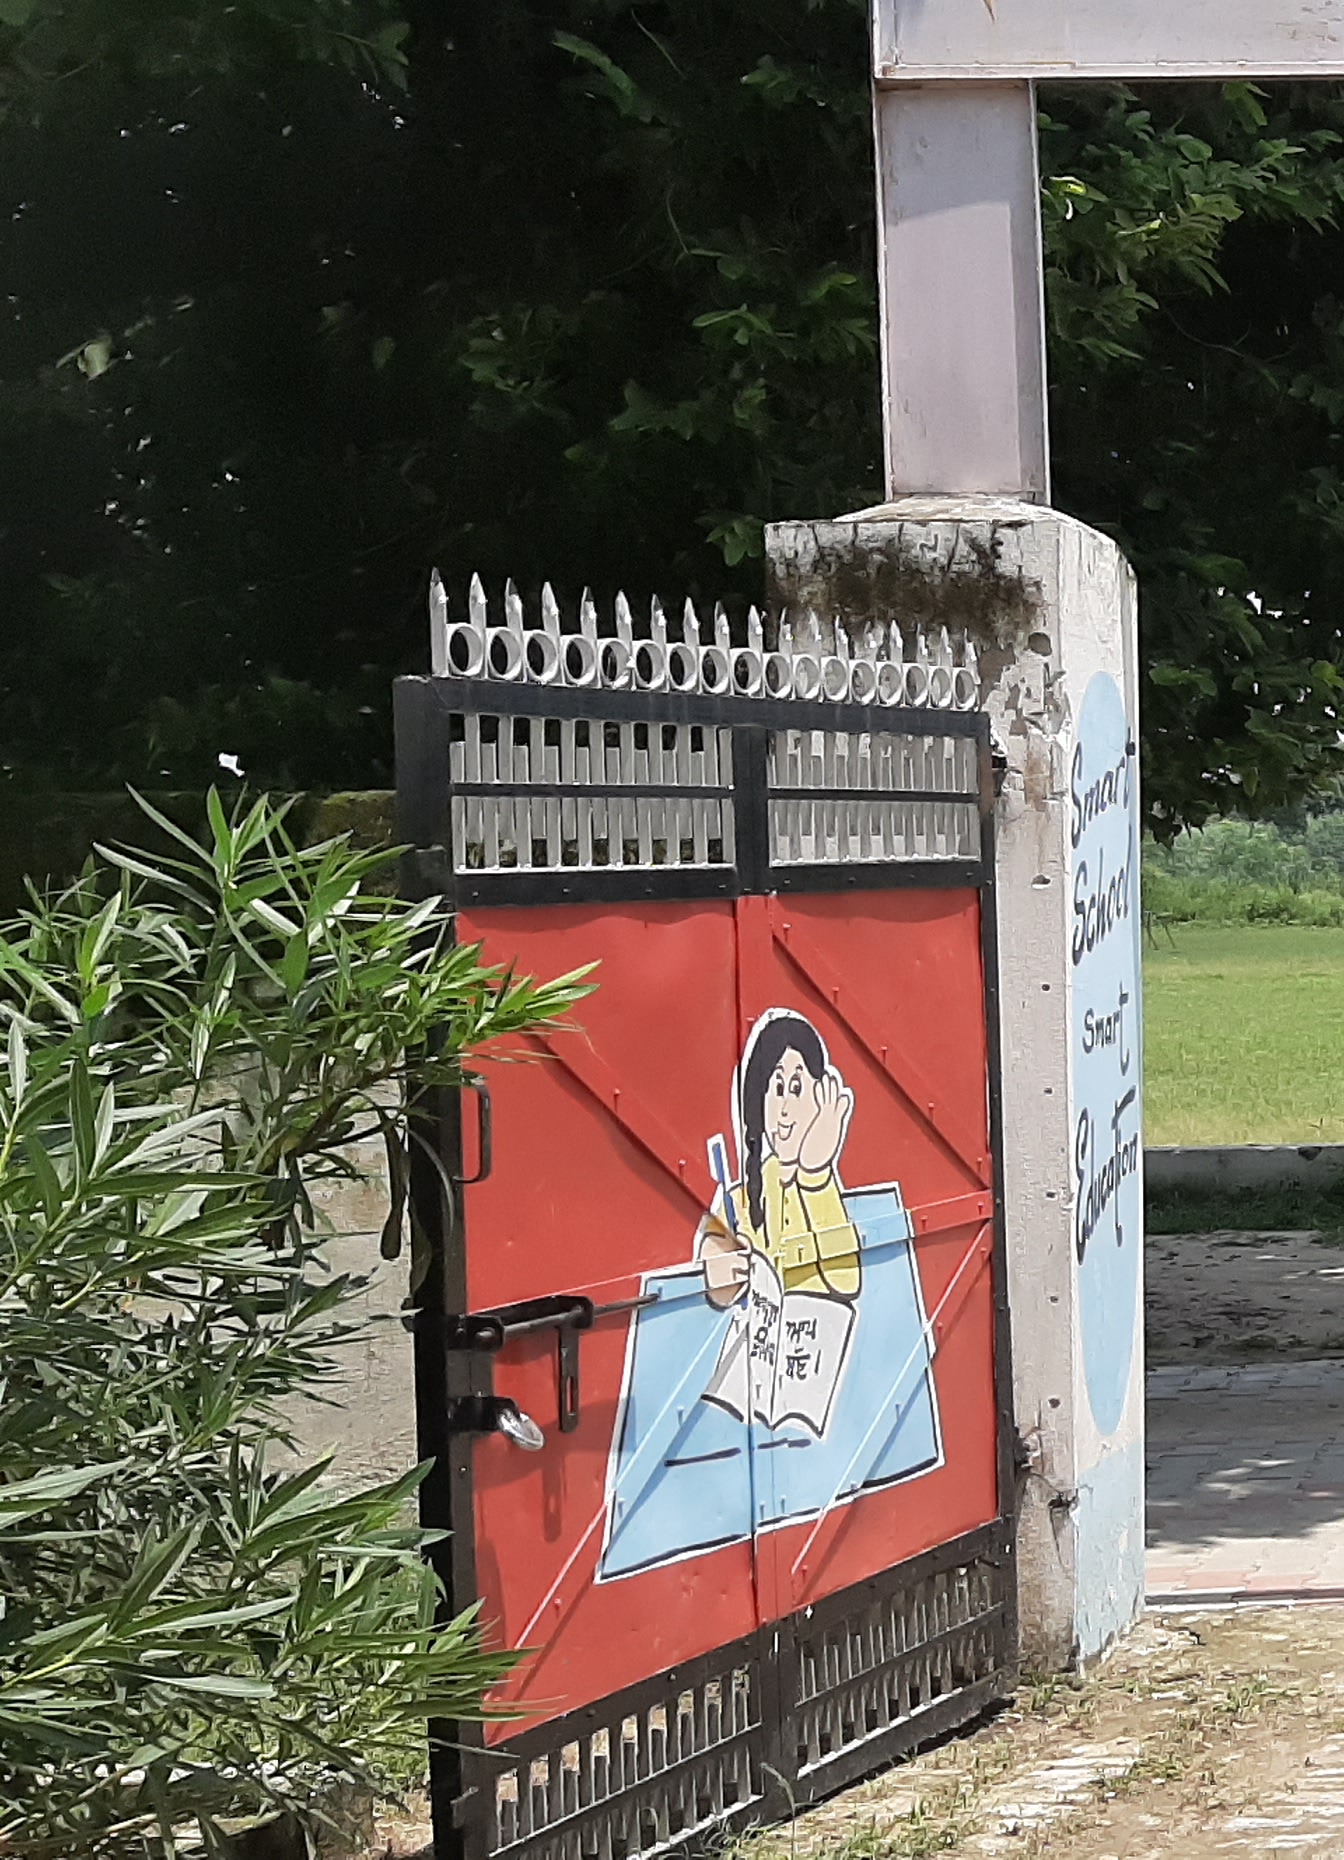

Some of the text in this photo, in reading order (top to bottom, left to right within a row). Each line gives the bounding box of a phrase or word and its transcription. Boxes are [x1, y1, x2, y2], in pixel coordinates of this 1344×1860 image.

[1071, 726, 1136, 850] Smart
[1072, 823, 1133, 967] School
[1075, 1084, 1139, 1266] Education
